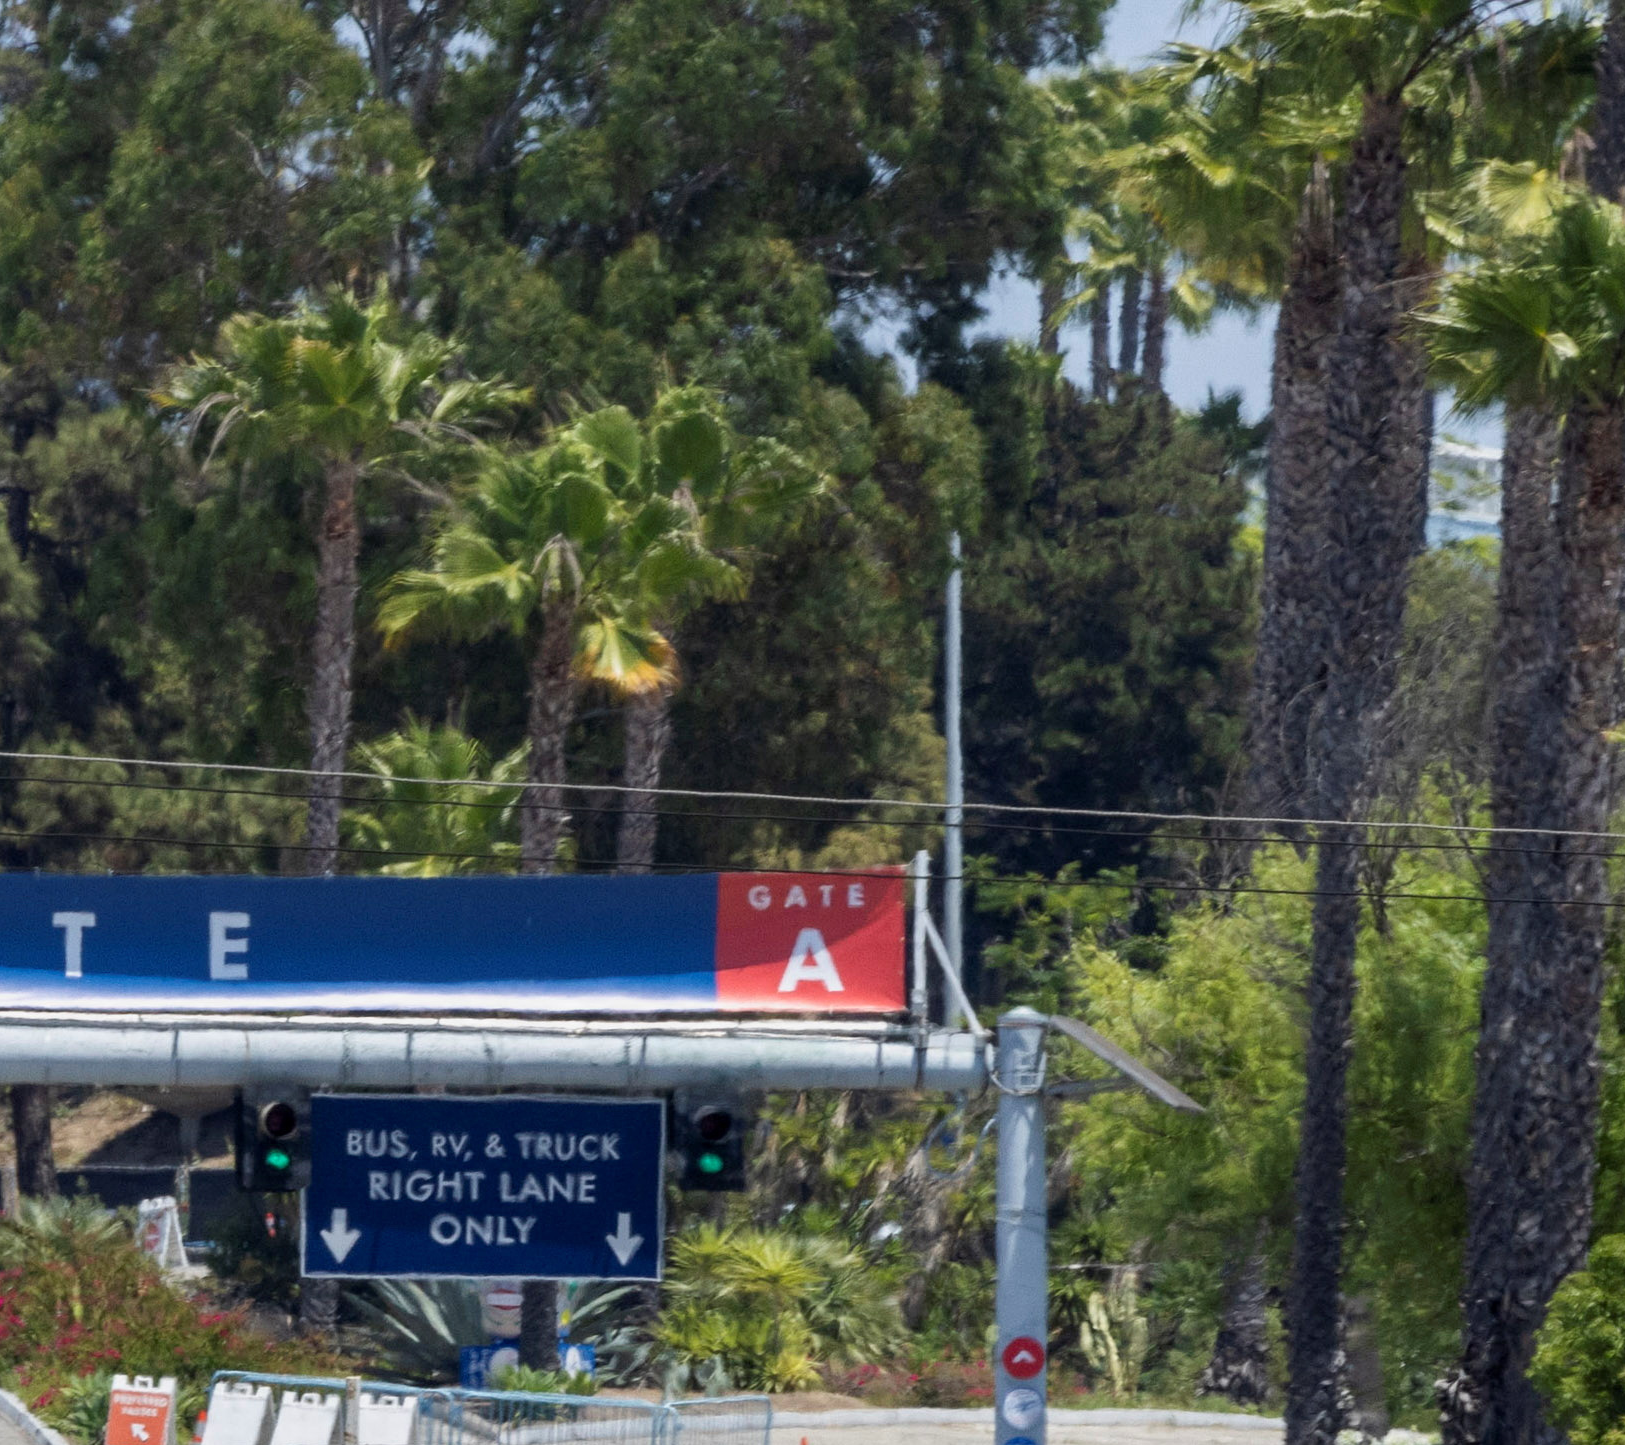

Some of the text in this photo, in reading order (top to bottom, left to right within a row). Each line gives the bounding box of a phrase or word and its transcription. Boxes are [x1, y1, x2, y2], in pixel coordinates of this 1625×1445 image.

[747, 883, 866, 911] GATE
[779, 926, 845, 993] A
[346, 1129, 620, 1162] BUS, RV, & TRUCK
[368, 1170, 597, 1204] RIGHT LANE
[429, 1213, 537, 1247] ONLY
